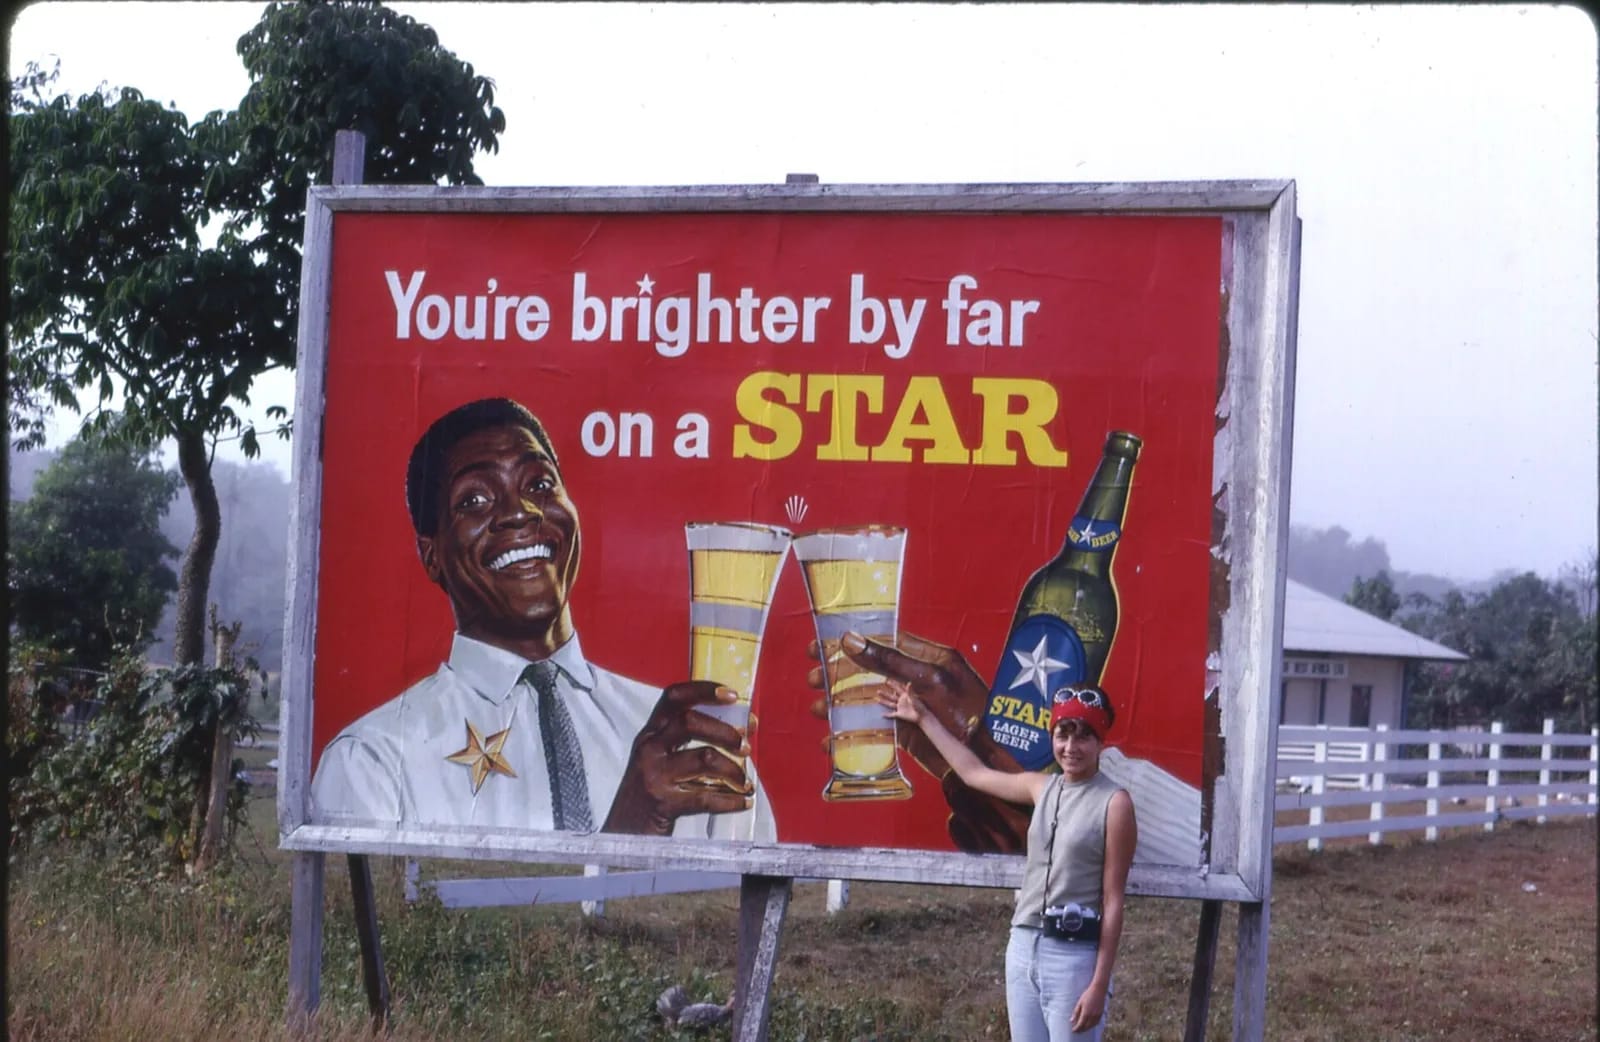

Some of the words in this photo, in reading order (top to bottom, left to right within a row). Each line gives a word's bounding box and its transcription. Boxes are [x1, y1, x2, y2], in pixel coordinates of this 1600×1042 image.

[384, 270, 550, 342] You're
[571, 271, 831, 358] brighter
[848, 272, 927, 360] by
[941, 274, 1041, 347] far
[580, 410, 654, 458] on
[673, 412, 710, 460] a
[732, 370, 1068, 468] STAR
[1091, 530, 1118, 548] BEER
[988, 695, 1052, 731] STAR
[991, 719, 1040, 744] LAGER
[992, 731, 1031, 752] BEER
